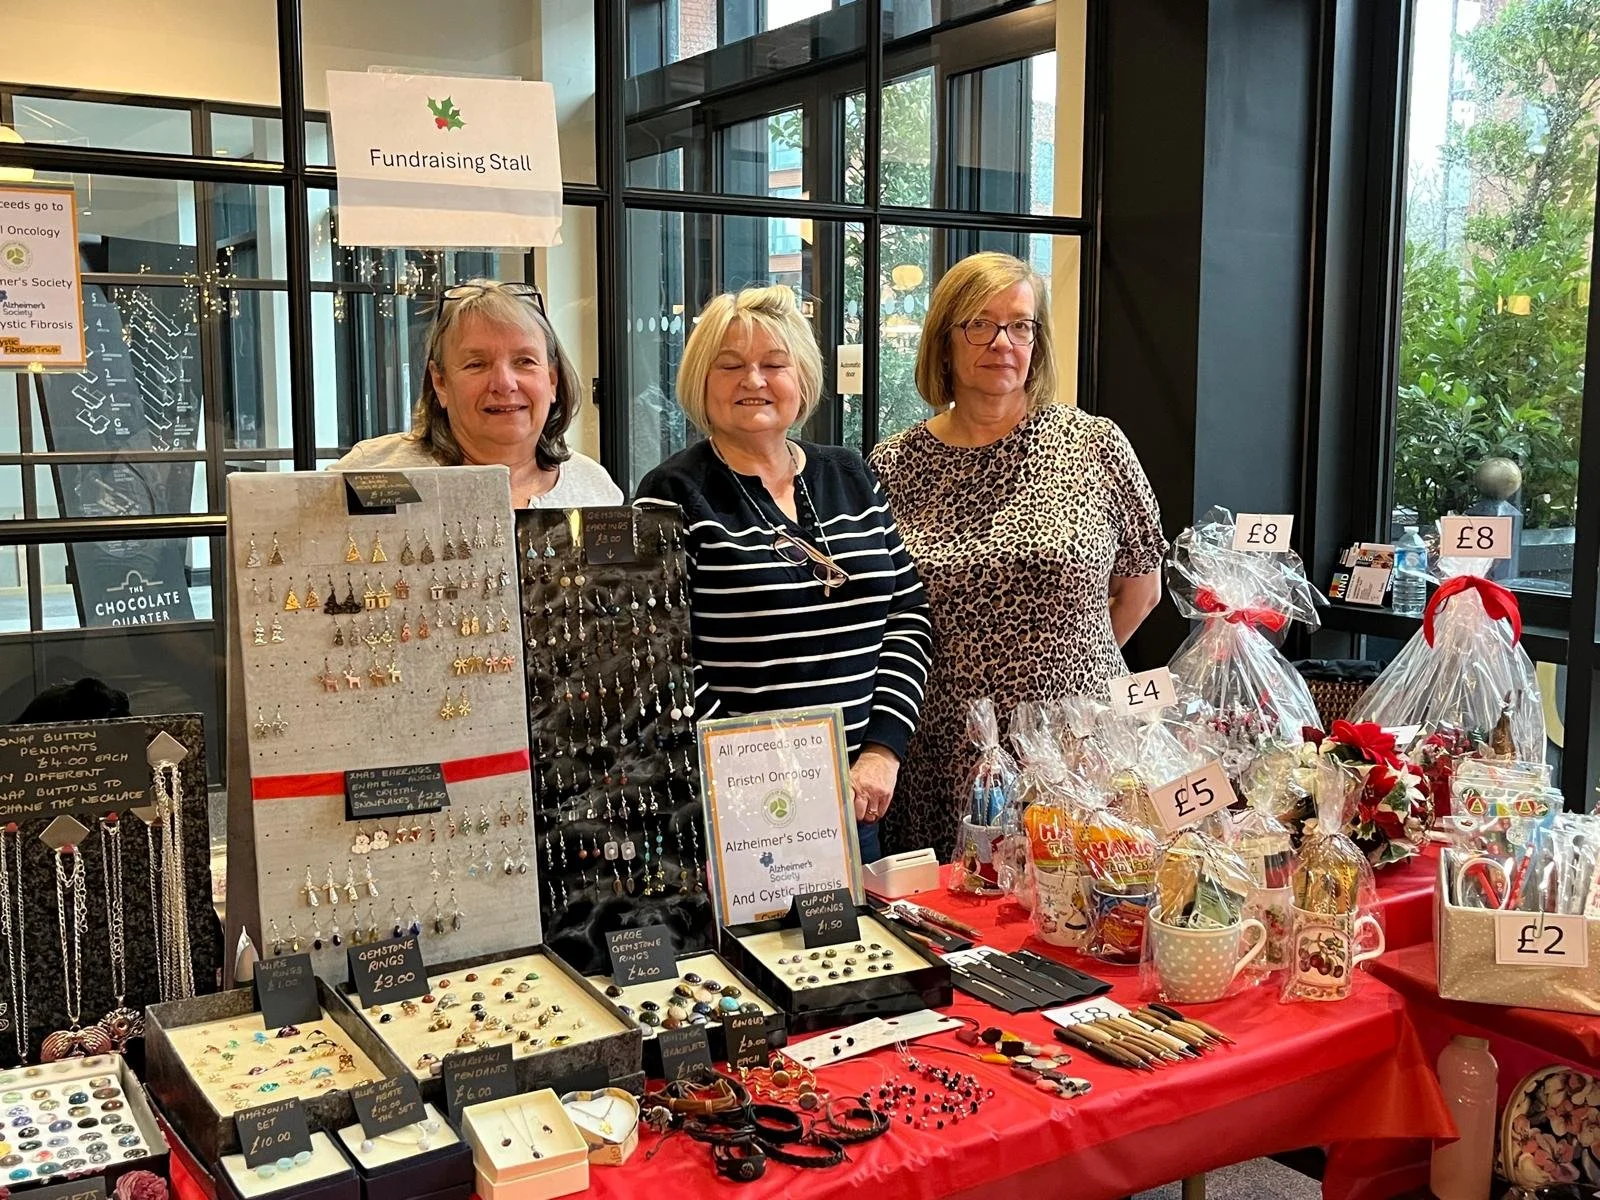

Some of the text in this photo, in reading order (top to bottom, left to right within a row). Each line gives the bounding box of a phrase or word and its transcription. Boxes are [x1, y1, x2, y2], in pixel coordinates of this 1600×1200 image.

[369, 148, 532, 174] Fundraising Stall
[34, 203, 49, 212] go
[52, 202, 64, 211] to
[7, 225, 61, 239] Oncology
[31, 277, 73, 290] Society
[2, 301, 46, 310] Alzheimer's
[2, 308, 33, 318] Society
[30, 319, 74, 330] Fibrosis
[5, 345, 36, 354] Fibrosis
[1246, 522, 1278, 545] £8
[1455, 525, 1495, 551] £8
[128, 585, 144, 594] THE
[1336, 573, 1350, 599] KIND
[95, 591, 180, 616] CHOCOLATE
[112, 610, 170, 626] QUARTER
[1127, 679, 1160, 706] £4
[0, 731, 97, 747] SNAP BUTTON
[718, 735, 823, 758] All proceeds go to
[20, 743, 98, 757] PENDANTS
[37, 753, 129, 769] £4.00 EACH
[24, 768, 106, 782] DIFFERENT
[727, 773, 765, 788] Bristol
[36, 783, 98, 797] BUTTONS
[104, 780, 122, 788] TO
[50, 797, 76, 809] THE
[353, 797, 410, 810] SNOWFLAKES
[1173, 777, 1215, 817] £5
[725, 828, 838, 853] Alzheimer's Society
[769, 860, 813, 874] Alzheimer's
[770, 872, 801, 883] Society
[732, 879, 842, 907] And Cystic Fibrosis
[805, 903, 844, 918] EARRINGS
[817, 919, 843, 935] £1.50
[611, 929, 643, 943] LARGE
[1516, 924, 1566, 955] £2
[358, 938, 415, 961] GEMSTONE
[611, 937, 662, 954] GEMSTONE
[367, 954, 405, 974] RINGS
[618, 951, 649, 963] RINGS
[627, 964, 661, 981] £4.00
[373, 971, 416, 993] £3.00
[454, 1063, 509, 1082] PENDANTS
[238, 1100, 297, 1122] AMAZONITE
[398, 1102, 417, 1115] SET
[256, 1116, 277, 1131] SET
[249, 1130, 291, 1156] £10.00
